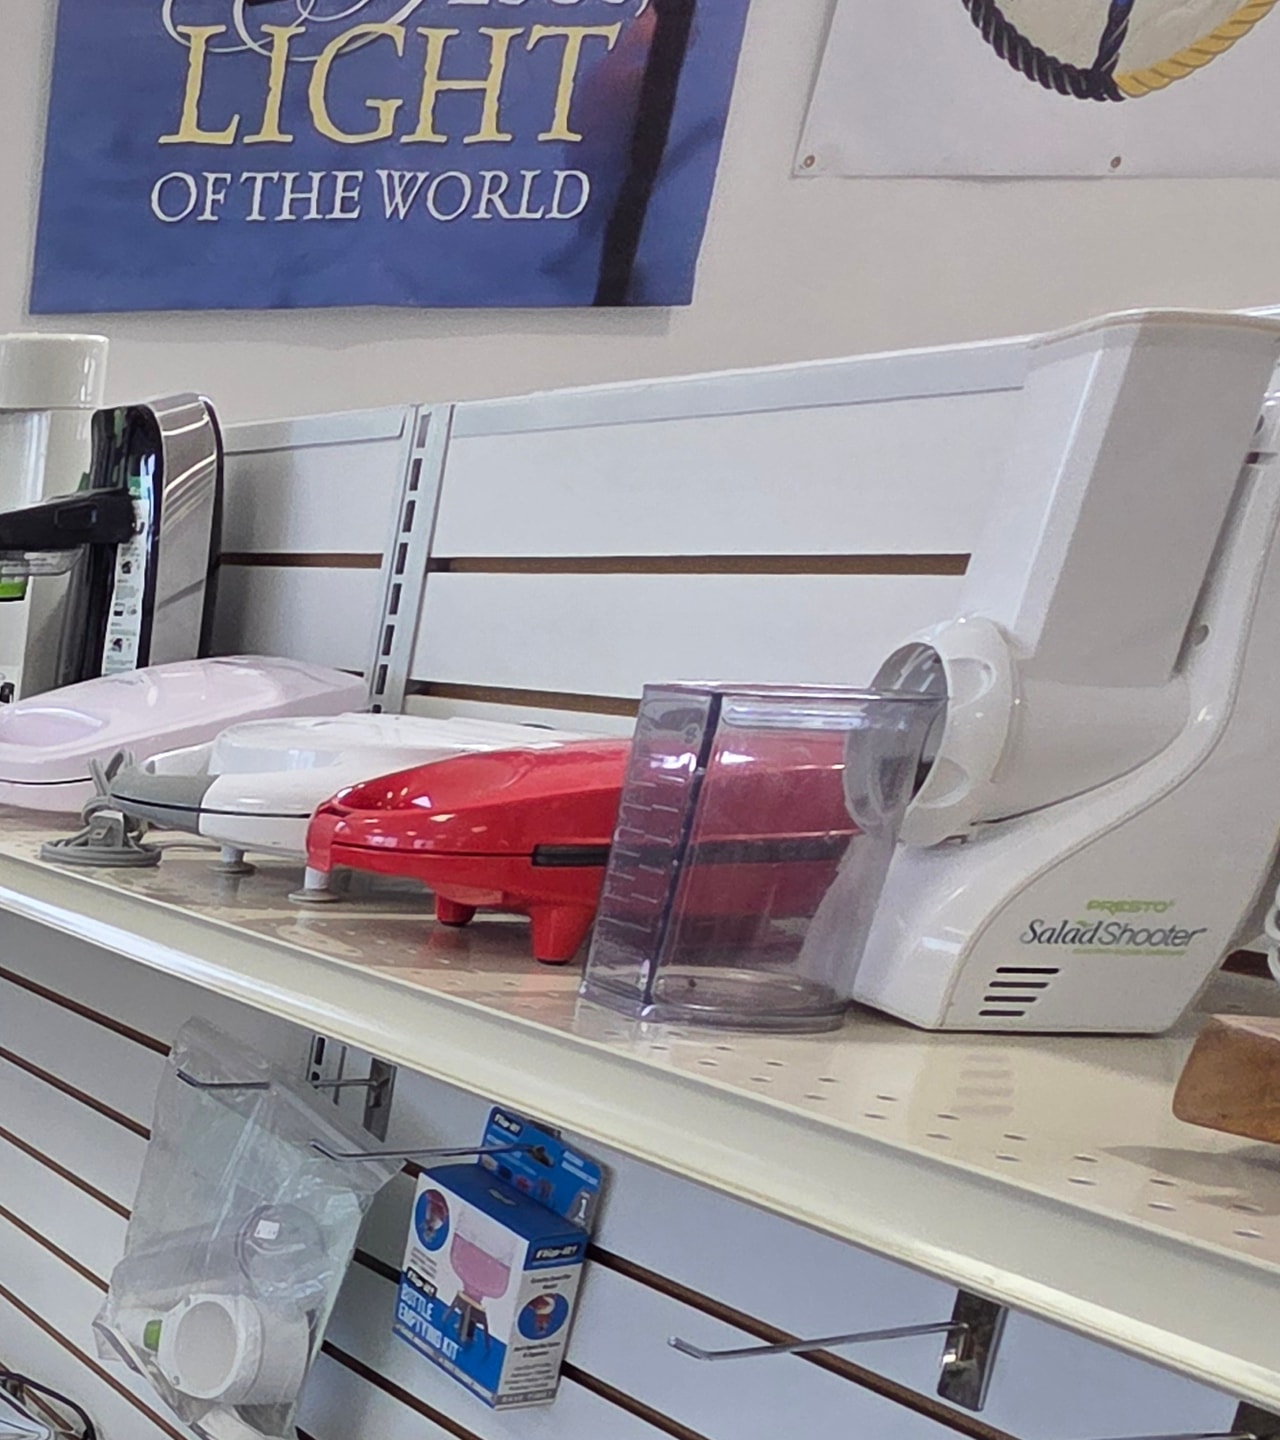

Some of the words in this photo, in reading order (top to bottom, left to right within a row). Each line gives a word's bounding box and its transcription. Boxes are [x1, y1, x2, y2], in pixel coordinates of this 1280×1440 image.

[158, 22, 623, 145] LIGHT
[151, 170, 231, 222] OF
[240, 170, 363, 221] THE
[376, 168, 590, 221] WORLD
[1086, 899, 1175, 916] PRESTO
[399, 1283, 434, 1322] BOTTLE
